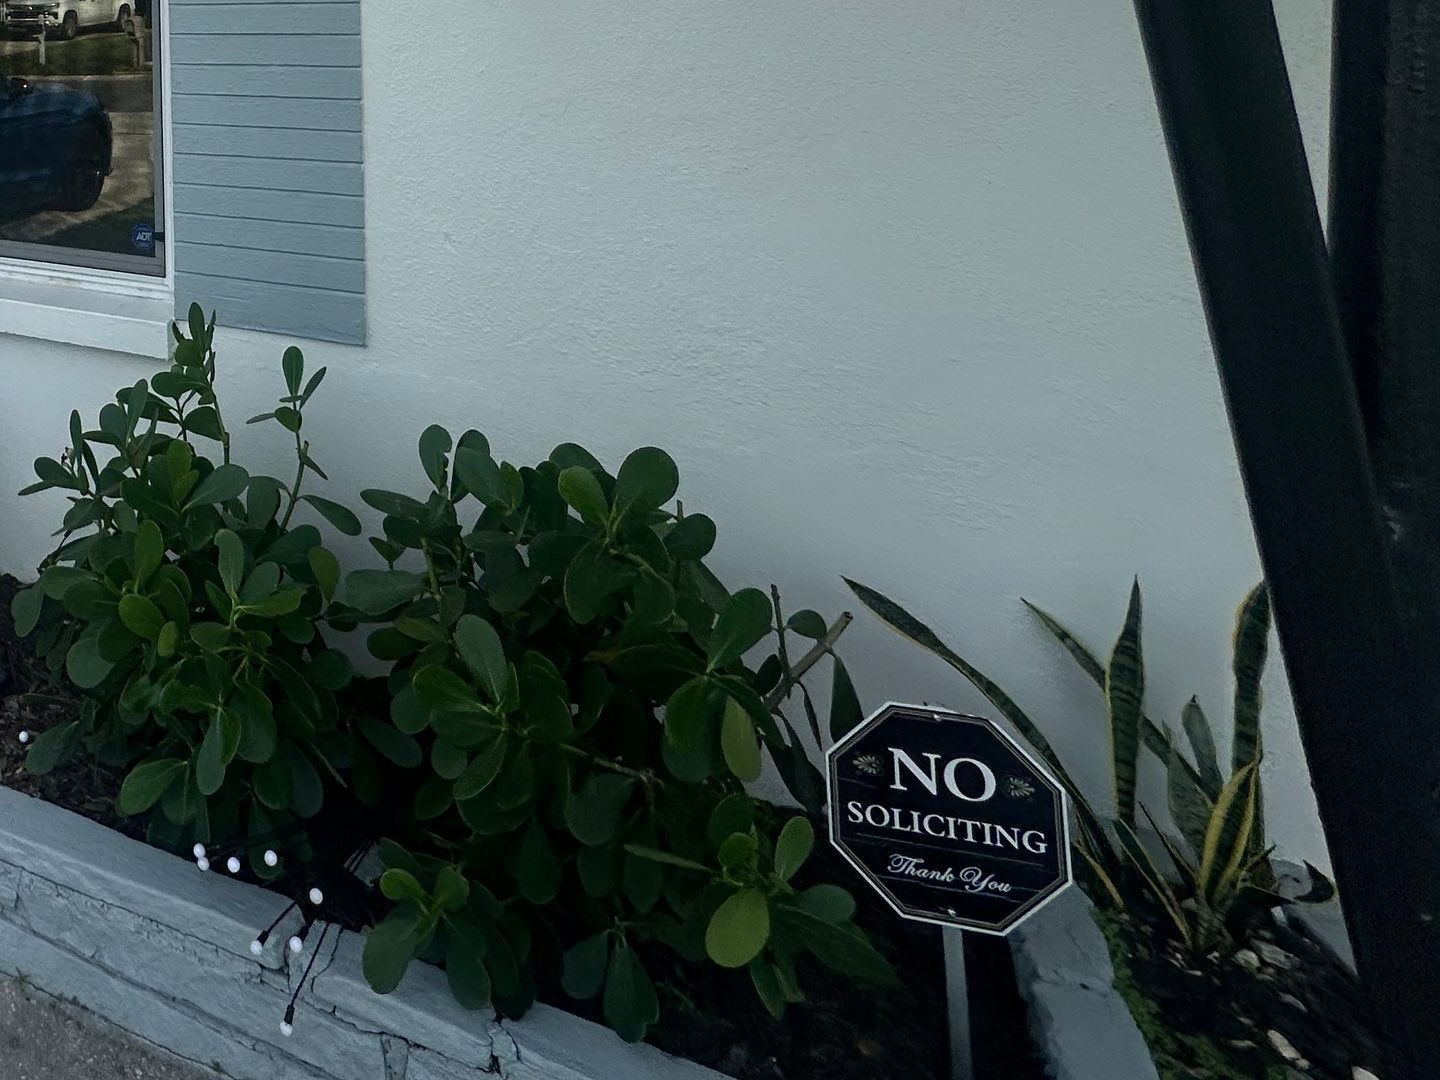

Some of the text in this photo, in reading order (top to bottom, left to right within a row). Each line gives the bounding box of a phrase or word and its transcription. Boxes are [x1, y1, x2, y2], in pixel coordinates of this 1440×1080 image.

[135, 231, 152, 241] ADT
[887, 746, 997, 802] NO
[847, 800, 1048, 855] SOLICITING
[887, 853, 1012, 893] Thank You
